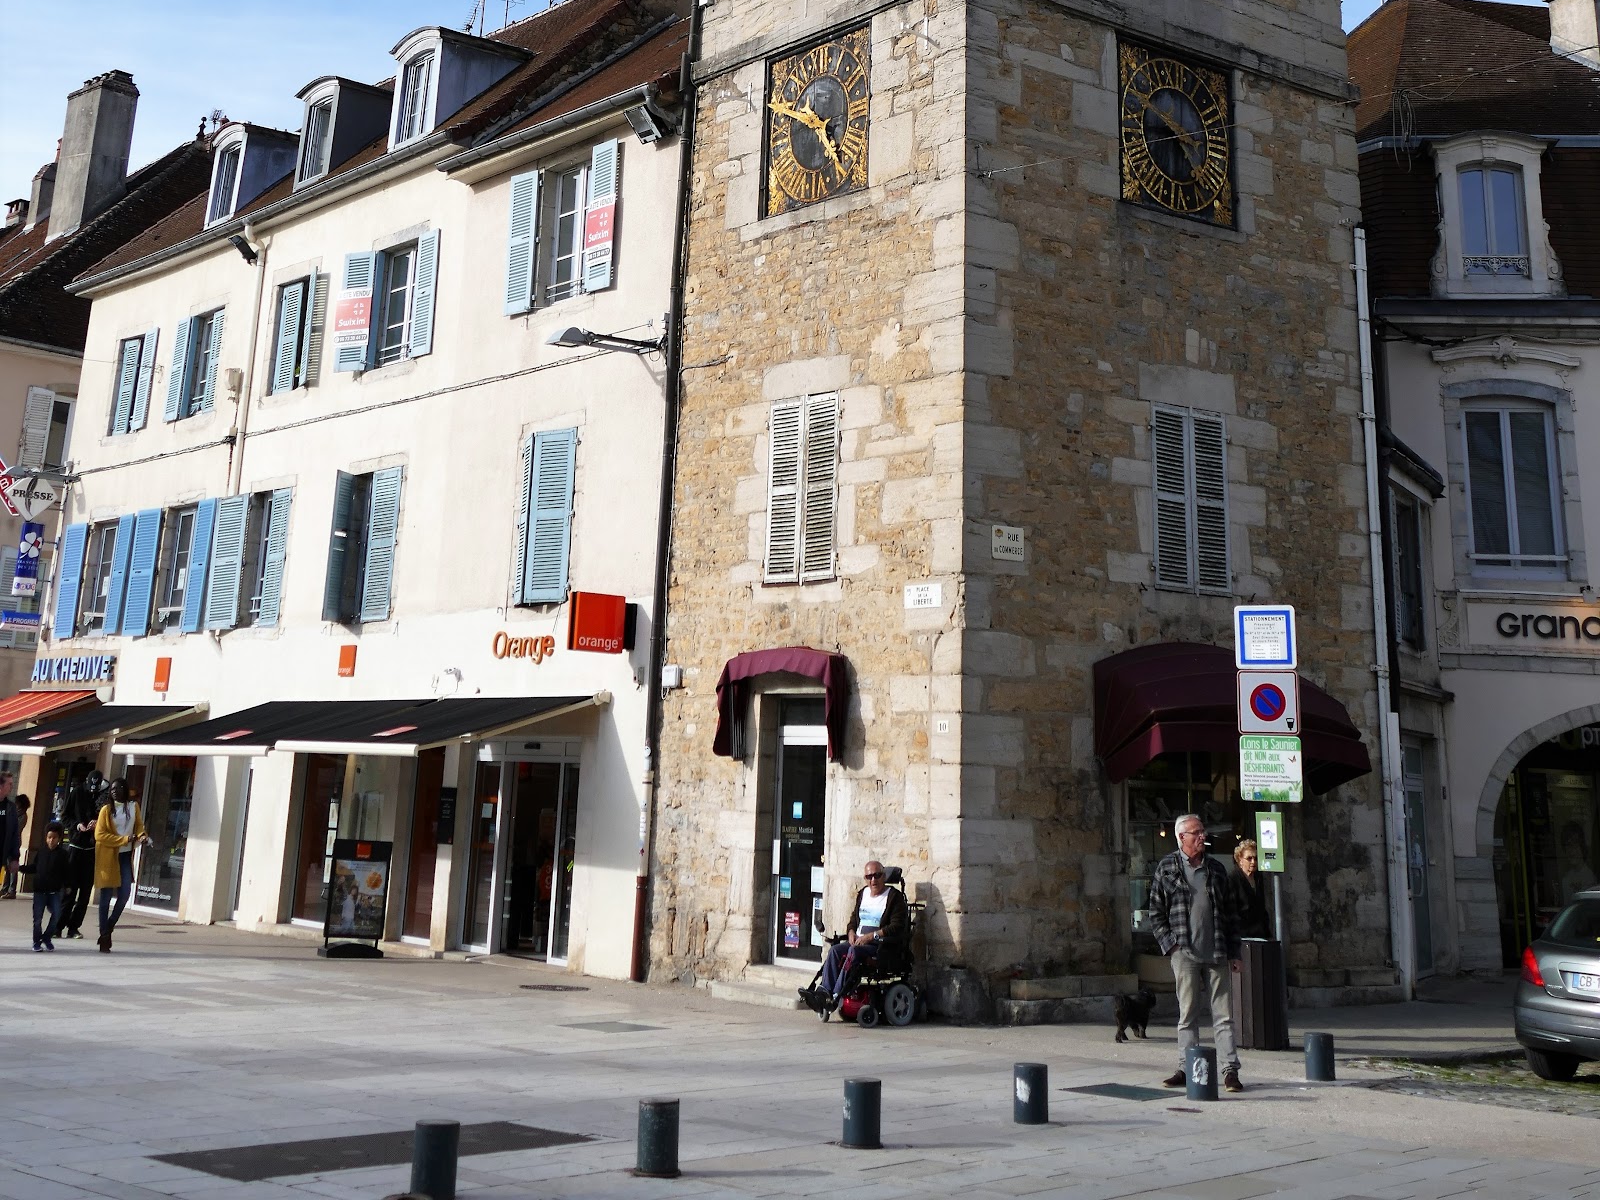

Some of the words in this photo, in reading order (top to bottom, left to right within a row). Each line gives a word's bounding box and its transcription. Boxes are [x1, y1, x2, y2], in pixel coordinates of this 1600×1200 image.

[338, 317, 366, 328] Swixim
[12, 489, 54, 502] PRESSE
[1007, 533, 1019, 542] RUE
[999, 545, 1023, 556] COMMERCE
[14, 582, 36, 591] LOTO
[492, 631, 555, 665] Orange
[578, 636, 619, 651] orange
[31, 658, 50, 681] AU
[51, 655, 113, 682] KHEDIVE
[939, 722, 947, 731] 10
[1243, 738, 1261, 750] Lons
[1262, 738, 1268, 750] le
[1270, 738, 1297, 751] Saunier
[1244, 751, 1253, 761] dit
[1254, 751, 1267, 761] NON
[1268, 753, 1281, 761] aux
